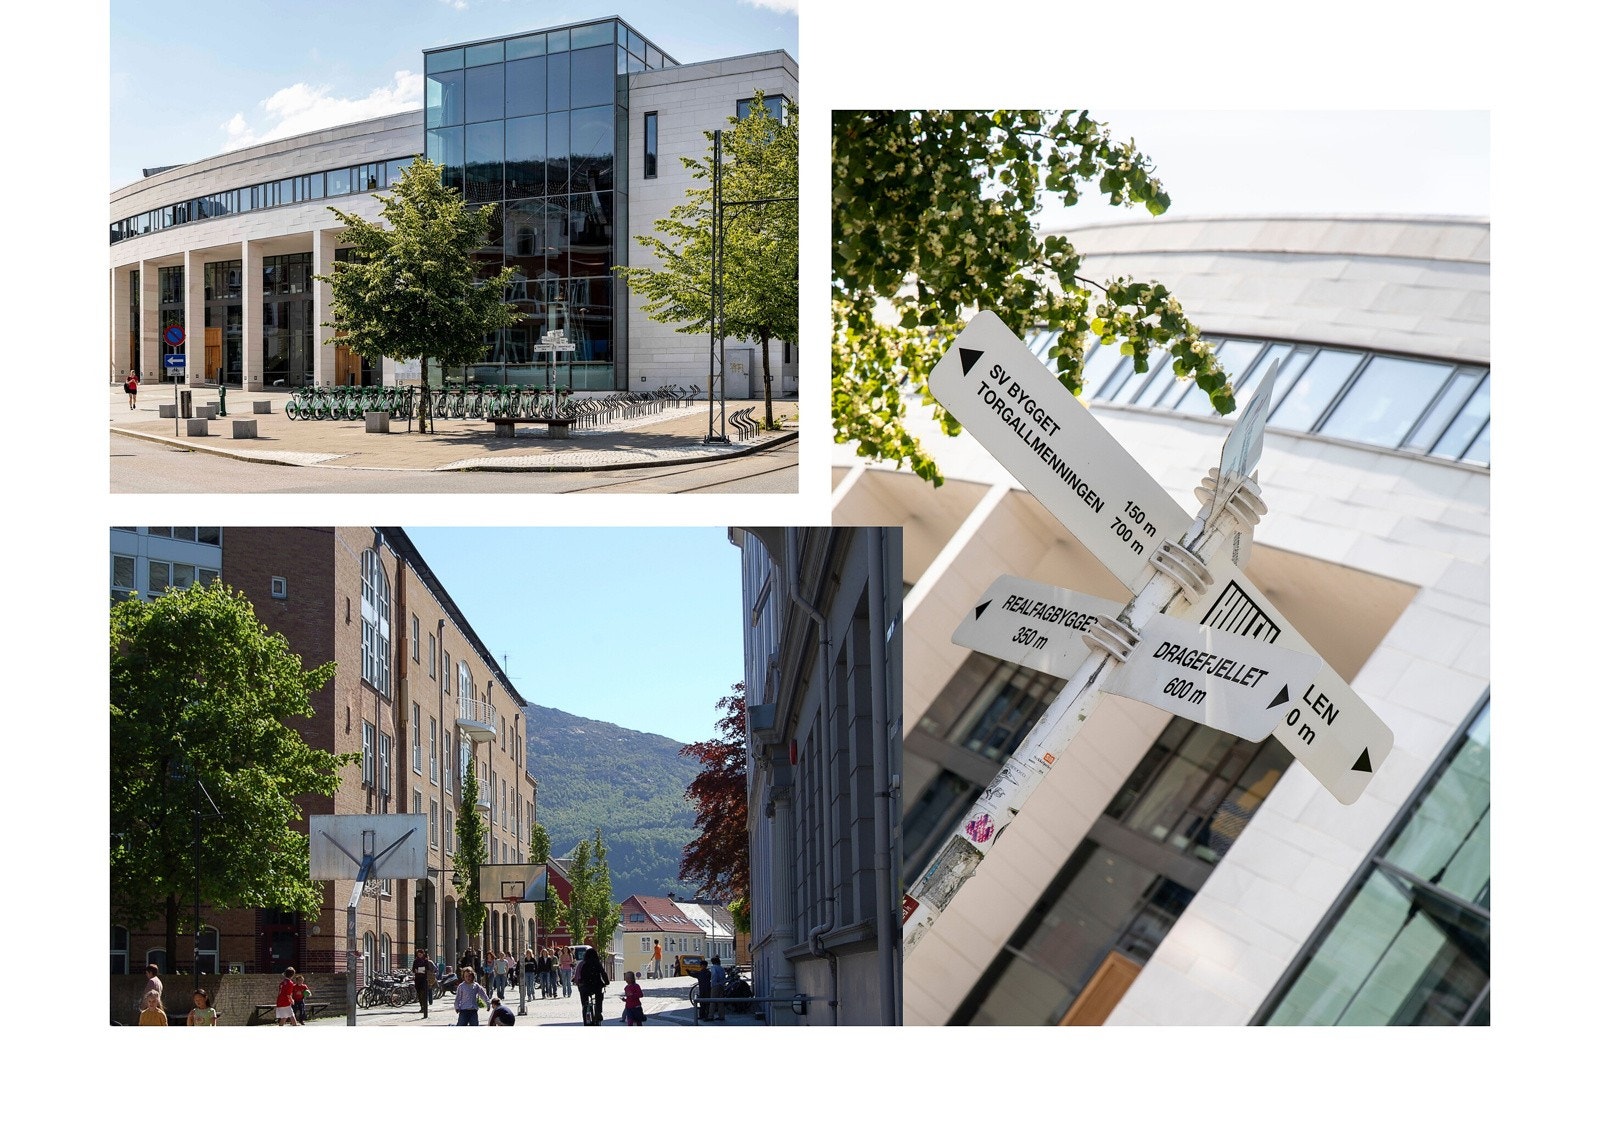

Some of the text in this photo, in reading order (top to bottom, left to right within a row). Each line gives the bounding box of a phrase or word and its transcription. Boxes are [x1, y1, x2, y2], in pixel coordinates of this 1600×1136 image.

[989, 364, 1061, 437] SV BYGGET
[976, 380, 1105, 514] TORGALLMENNINGEN
[1110, 516, 1144, 556] 700 m
[1123, 500, 1157, 538] 150 m
[1012, 627, 1048, 650] 350 m
[1153, 641, 1269, 688] DRAGEFJELLET
[1163, 677, 1207, 705] 600 m
[1302, 684, 1340, 726] LEN
[1284, 708, 1316, 745] 0 m
